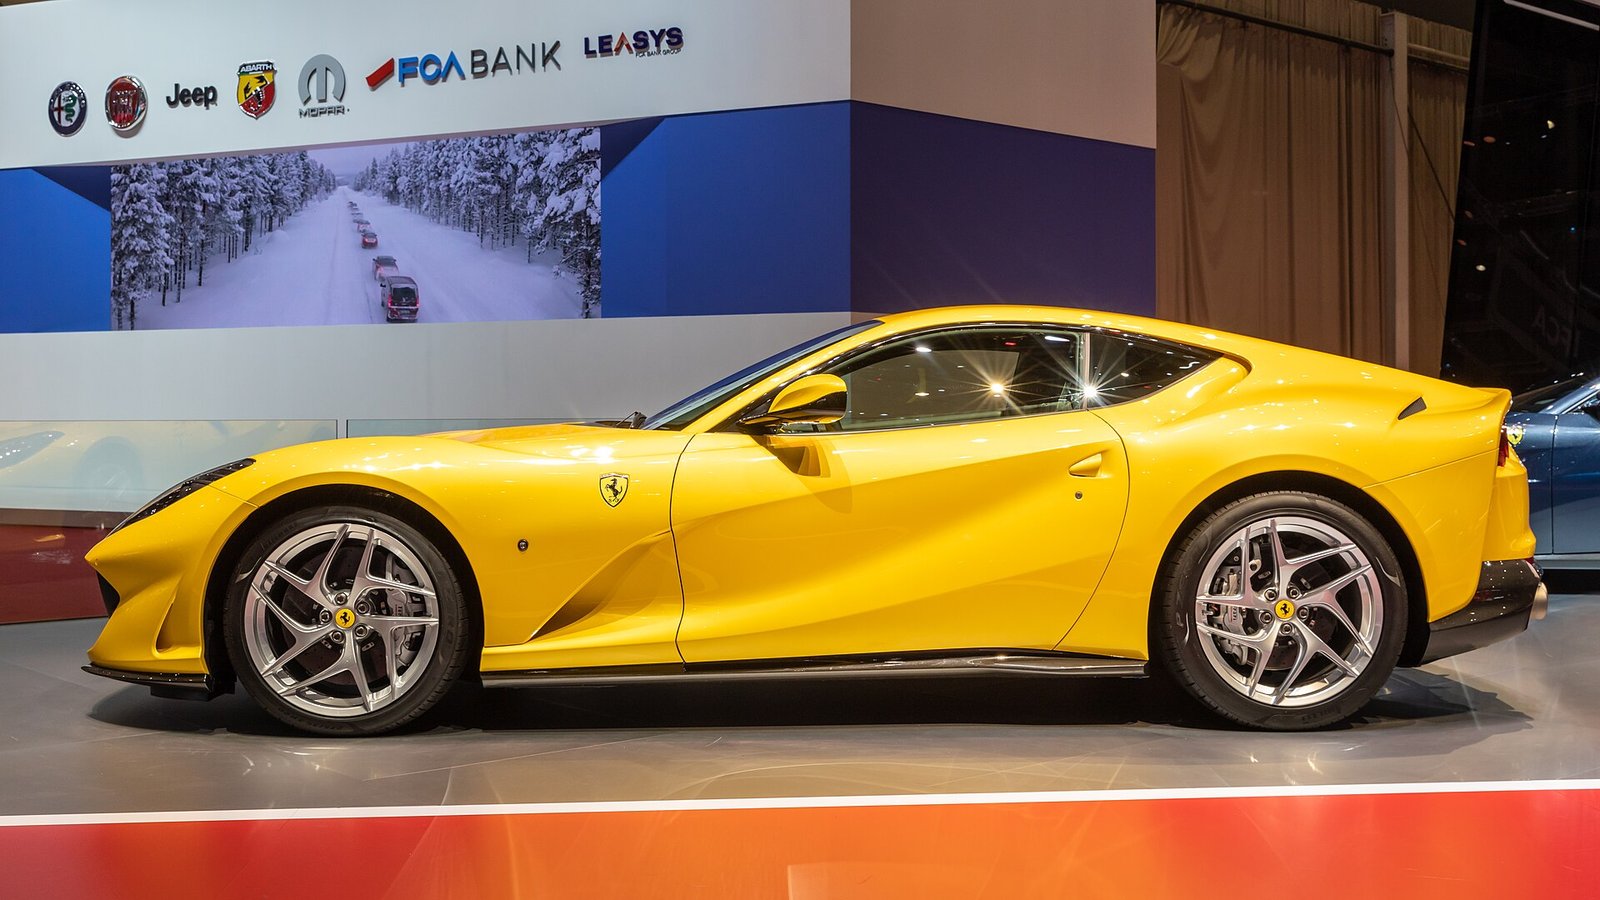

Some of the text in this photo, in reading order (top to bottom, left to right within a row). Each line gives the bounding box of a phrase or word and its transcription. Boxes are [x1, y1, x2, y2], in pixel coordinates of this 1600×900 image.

[584, 27, 684, 56] LEASYS
[240, 63, 273, 73] ABARTH
[398, 40, 561, 86] FCA BANK
[166, 83, 218, 109] Jeep
[299, 105, 346, 119] MOPAR
